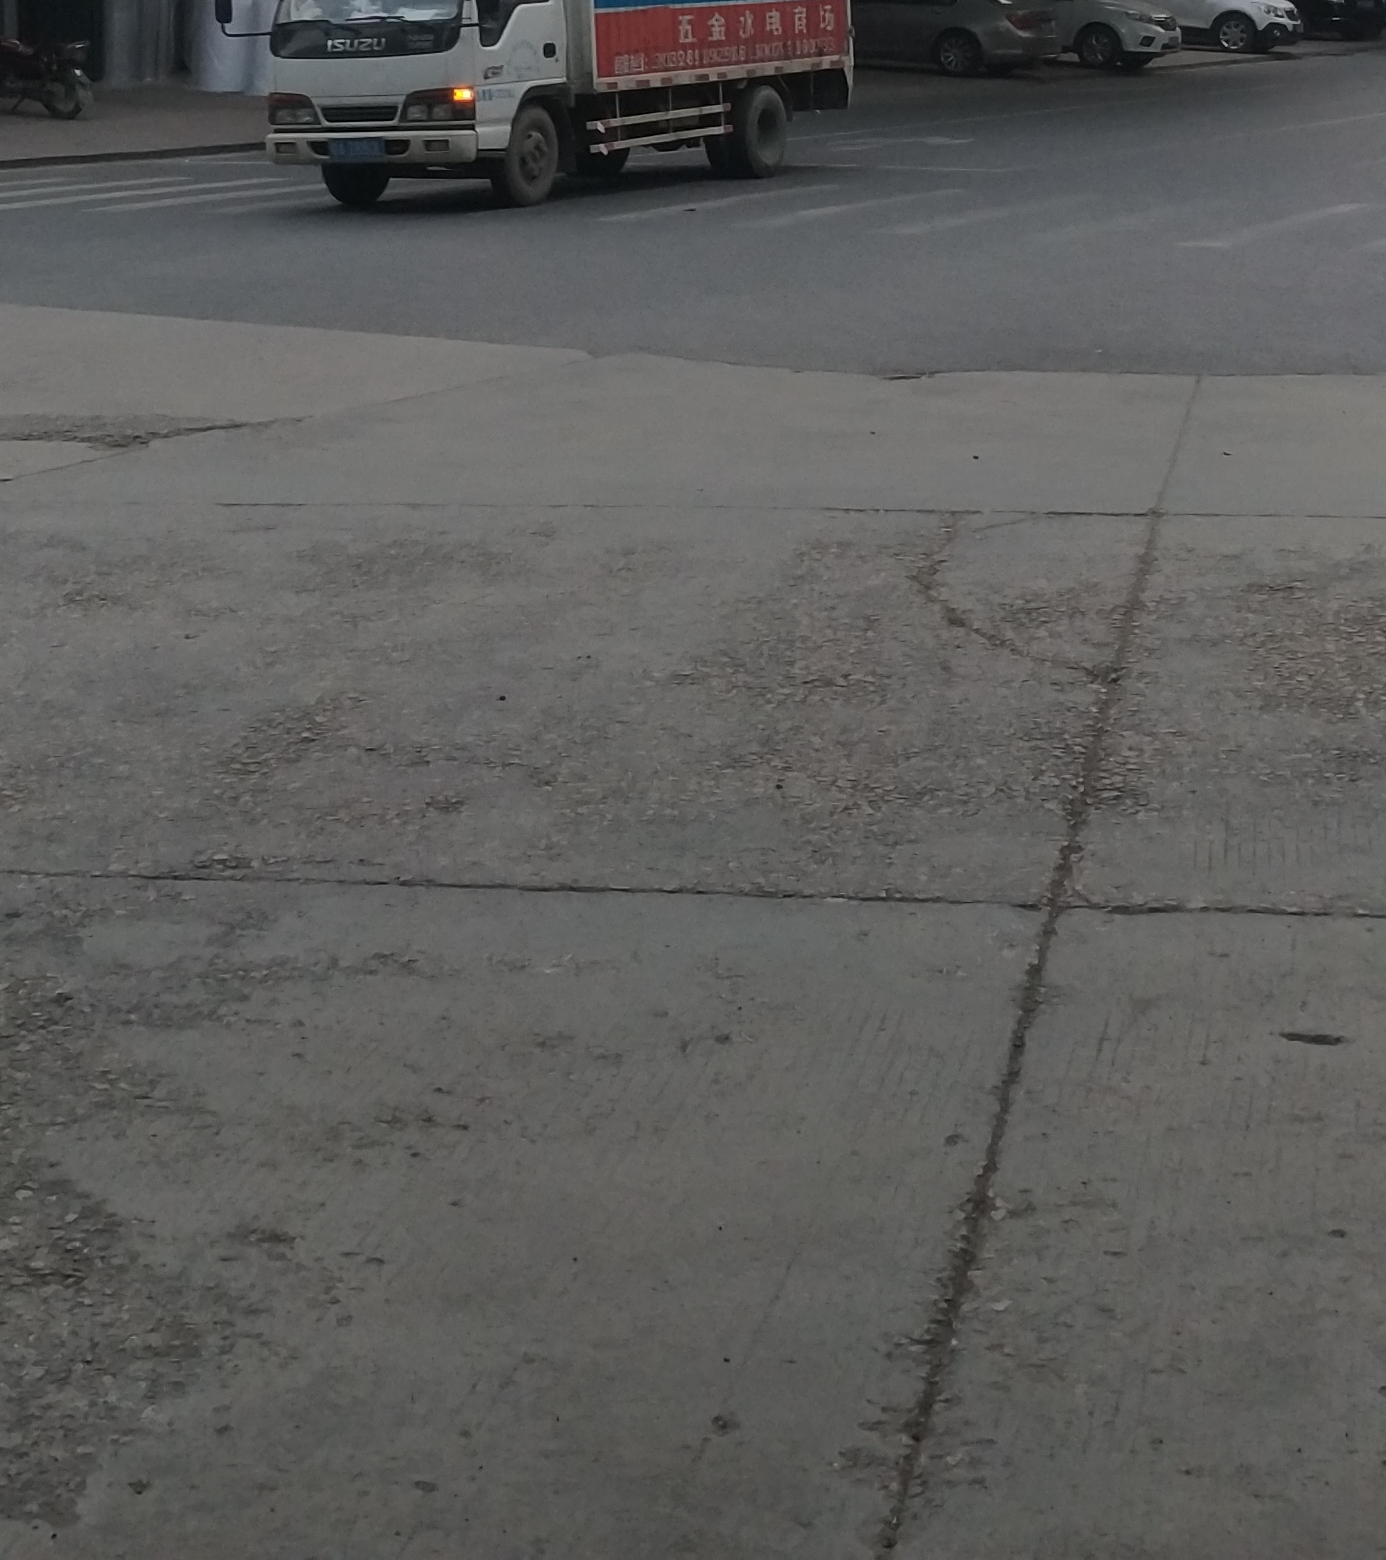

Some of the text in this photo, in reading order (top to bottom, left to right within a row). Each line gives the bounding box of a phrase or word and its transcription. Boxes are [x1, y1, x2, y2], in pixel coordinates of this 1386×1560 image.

[678, 3, 836, 44] 五金水电商场
[326, 37, 387, 53] ISUZU
